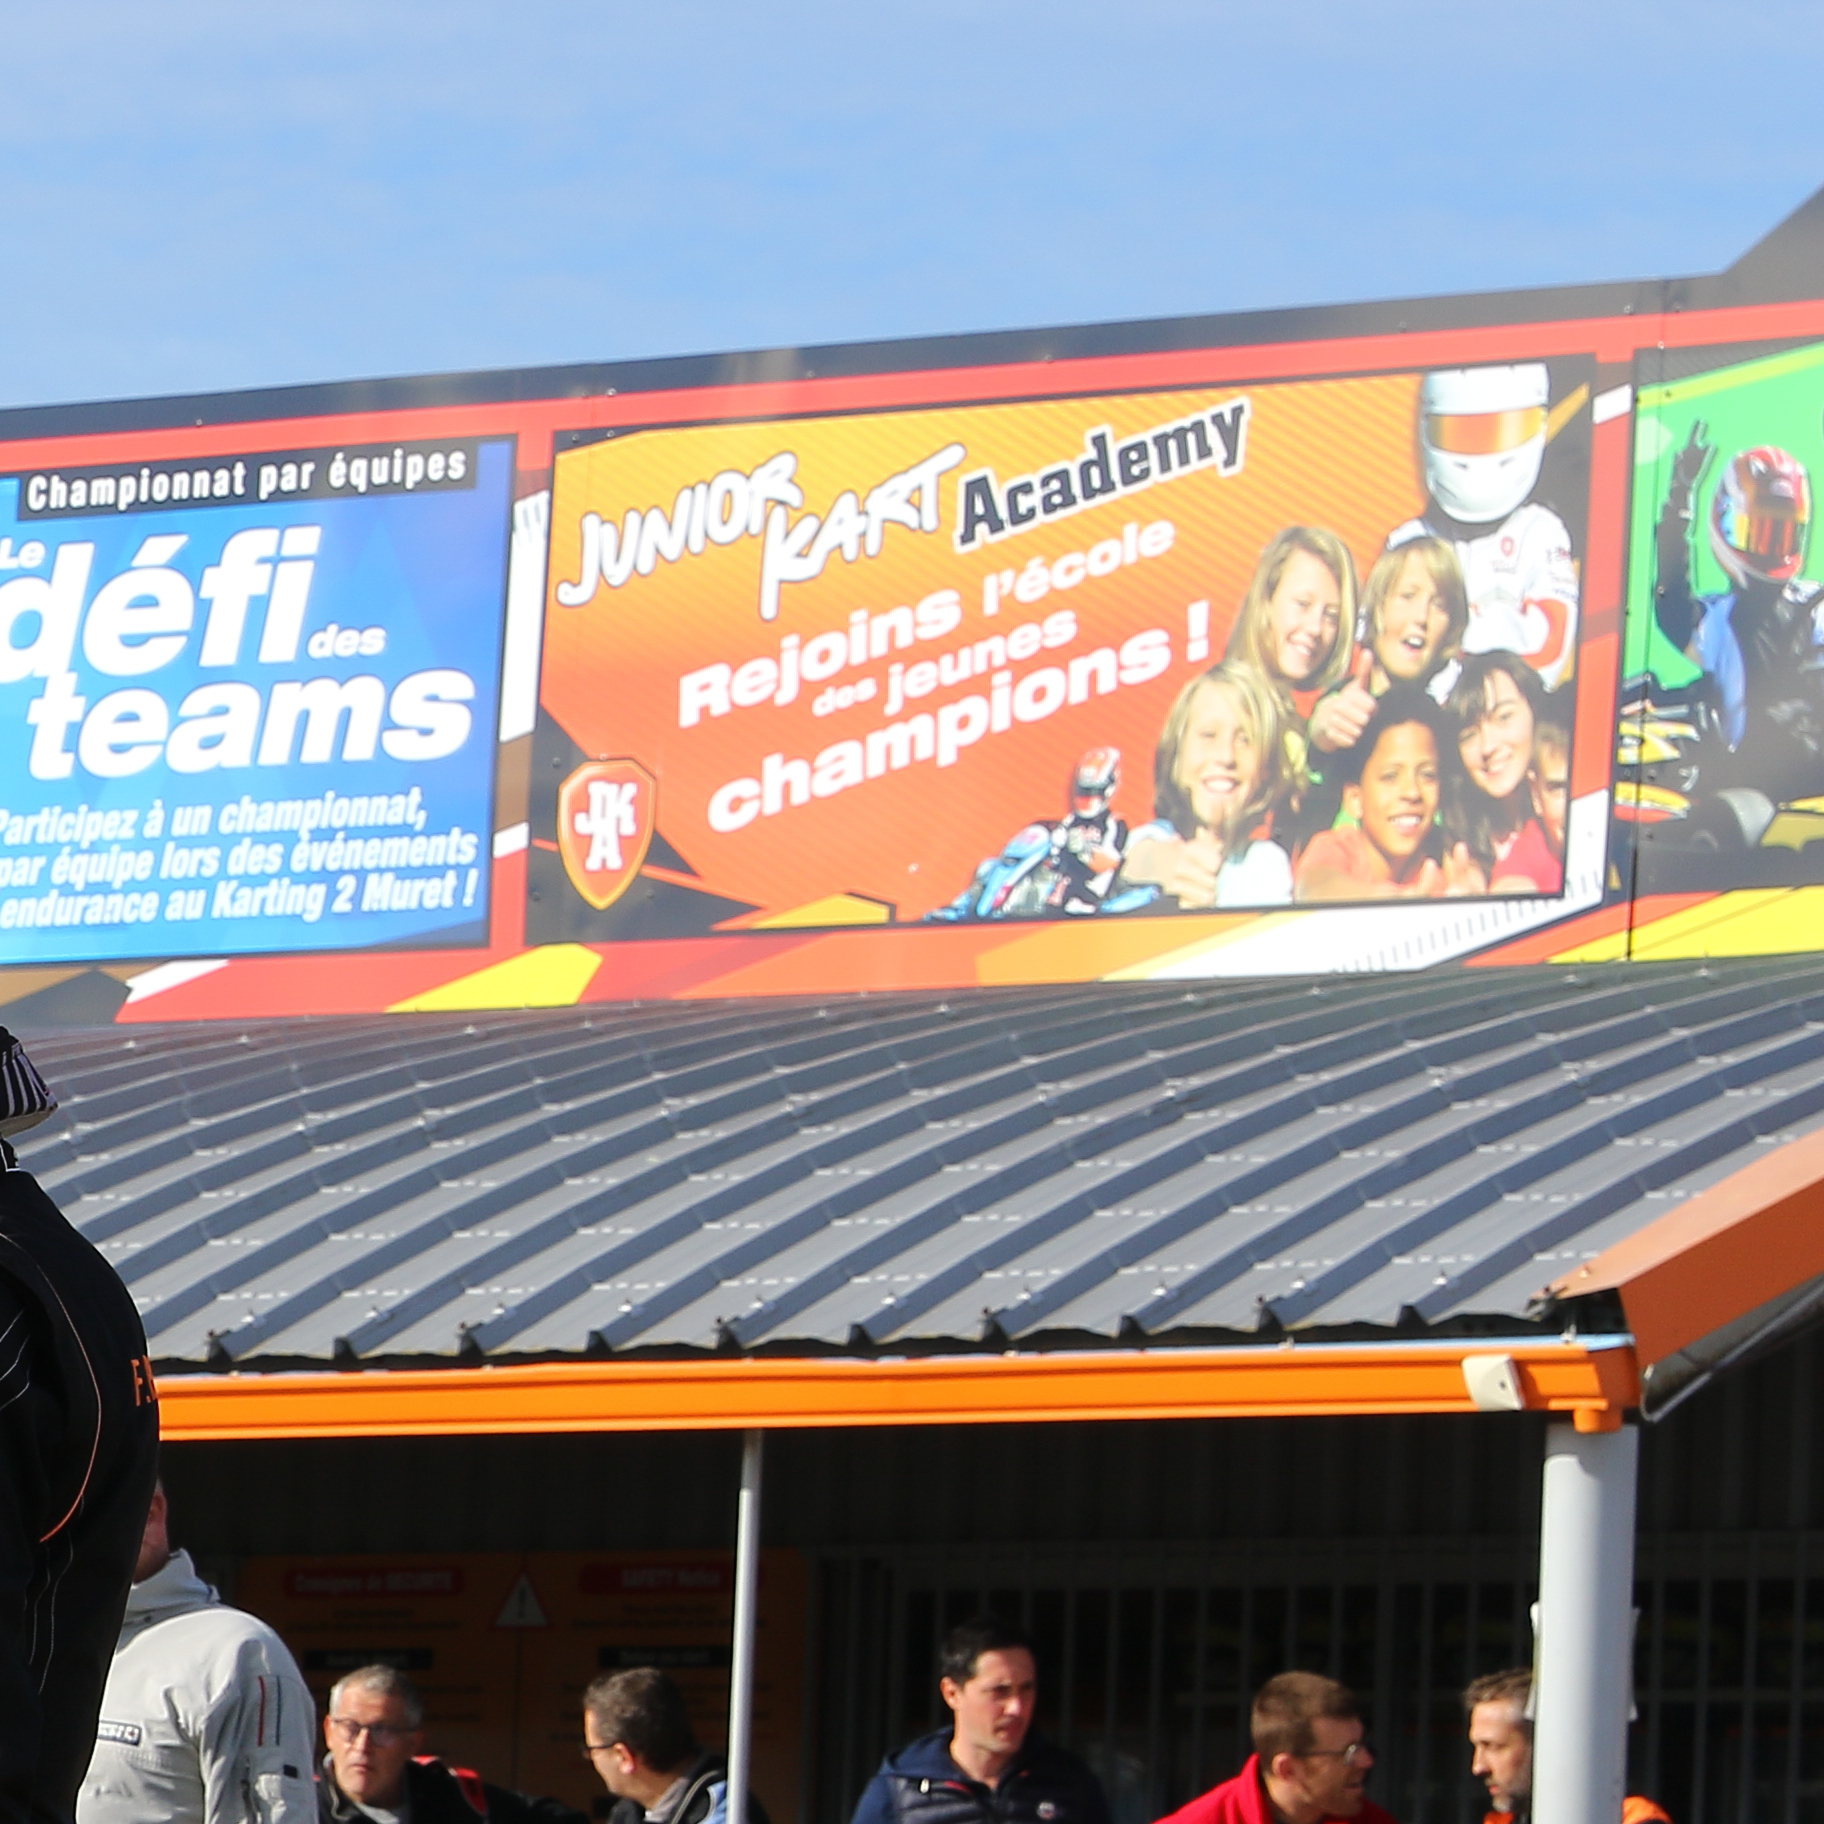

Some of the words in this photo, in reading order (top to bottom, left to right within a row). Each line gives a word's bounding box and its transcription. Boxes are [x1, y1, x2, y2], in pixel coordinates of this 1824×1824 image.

[27, 468, 246, 512] Championnat
[257, 459, 315, 501] par
[328, 451, 466, 492] équipes
[958, 401, 1248, 546] Academy
[558, 452, 803, 606] JUNIOR
[761, 444, 966, 621] KART
[308, 624, 386, 660] des
[680, 591, 961, 728] Rejoins
[814, 679, 877, 718] des
[885, 611, 1077, 715] jeunes
[28, 669, 475, 780] teams
[708, 627, 1170, 832] champions
[1188, 601, 1211, 663] !
[51, 846, 156, 891] équipe
[160, 842, 220, 880] lors
[227, 838, 284, 877] des
[290, 827, 479, 873] événements
[143, 801, 164, 840] à
[171, 806, 213, 838] un
[218, 787, 427, 840] championnat,
[164, 892, 205, 922] au
[211, 875, 328, 923] Karting
[331, 875, 356, 912] 2
[360, 870, 459, 912] Muret
[462, 869, 479, 908] !
